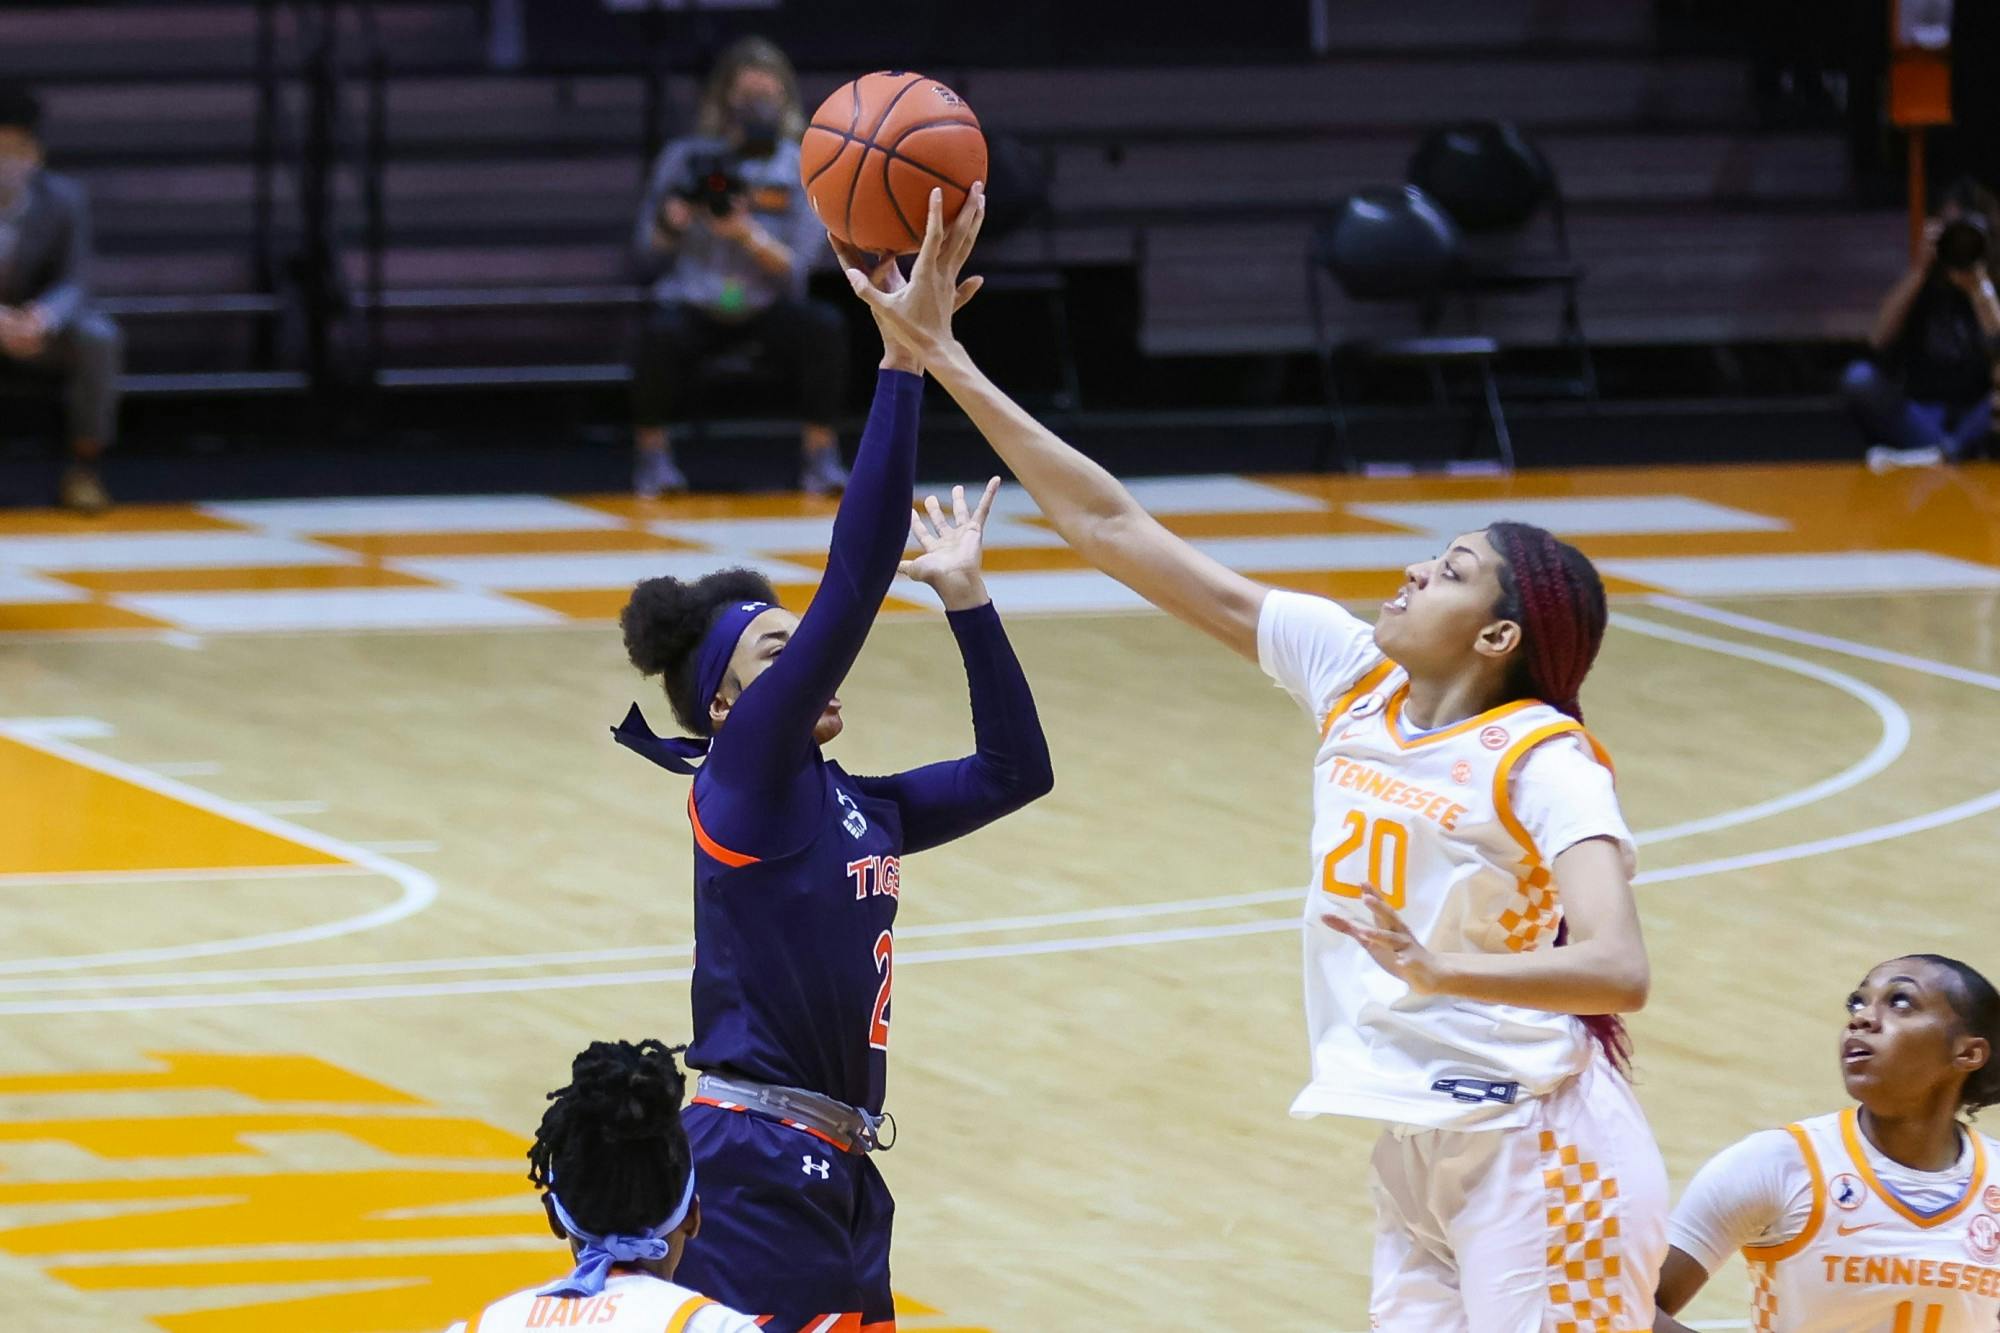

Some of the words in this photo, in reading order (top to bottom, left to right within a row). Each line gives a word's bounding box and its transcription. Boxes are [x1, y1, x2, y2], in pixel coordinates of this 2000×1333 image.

[1328, 757, 1469, 832] TENNESSEE
[1322, 808, 1409, 911] 20
[525, 1293, 624, 1328] DAVIS
